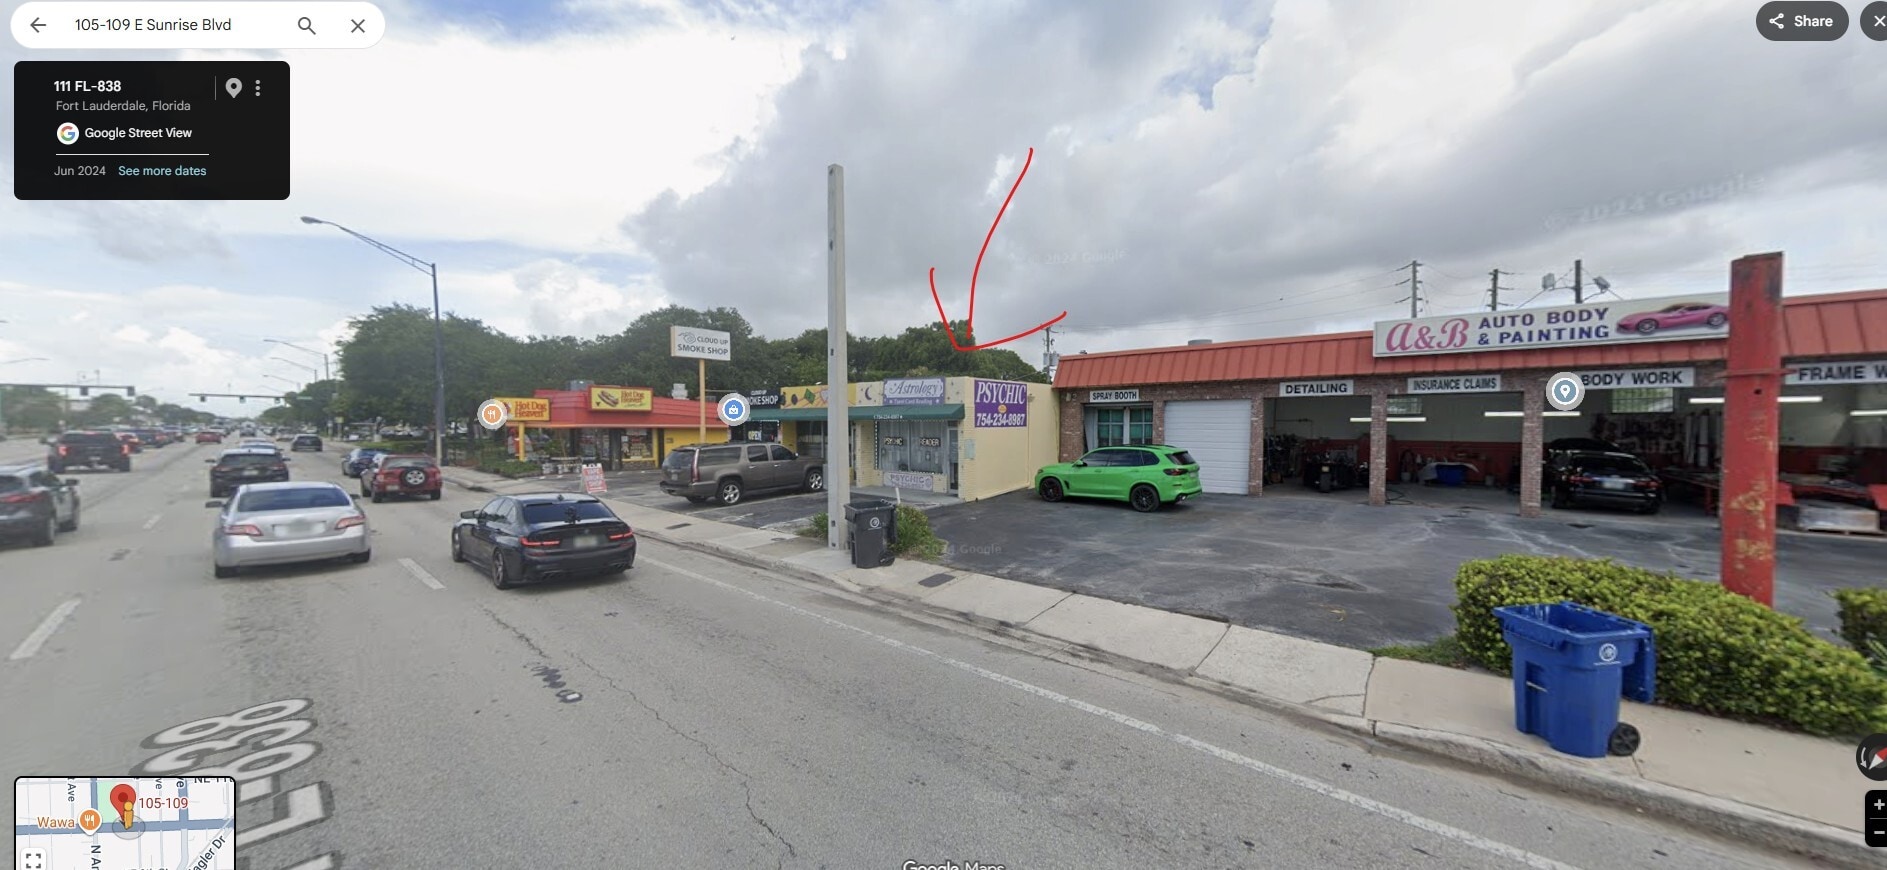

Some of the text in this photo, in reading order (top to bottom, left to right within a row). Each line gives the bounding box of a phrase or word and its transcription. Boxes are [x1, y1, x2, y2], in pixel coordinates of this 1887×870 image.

[1478, 307, 1609, 330] AUTO BODY
[697, 336, 719, 344] CLOUD
[1385, 318, 1470, 351] A&B
[1478, 325, 1609, 345] & PAINTING
[677, 343, 729, 356] SMOKE SHOP
[1580, 371, 1683, 386] BODY WORK
[1799, 365, 1866, 381] FRAME
[889, 381, 938, 396] Astrology
[1285, 383, 1348, 394] DETAILING
[1413, 377, 1498, 391] INSURANCE CLAIMS
[761, 395, 779, 405] SHOP
[976, 382, 1027, 404] PSYCHIC
[1092, 391, 1137, 400] SPRAY BOOTH
[514, 401, 548, 412] Hot Dog
[514, 408, 544, 418] Heaven
[976, 413, 1025, 427] 754-234-8987
[890, 473, 925, 484] PSYCHIC
